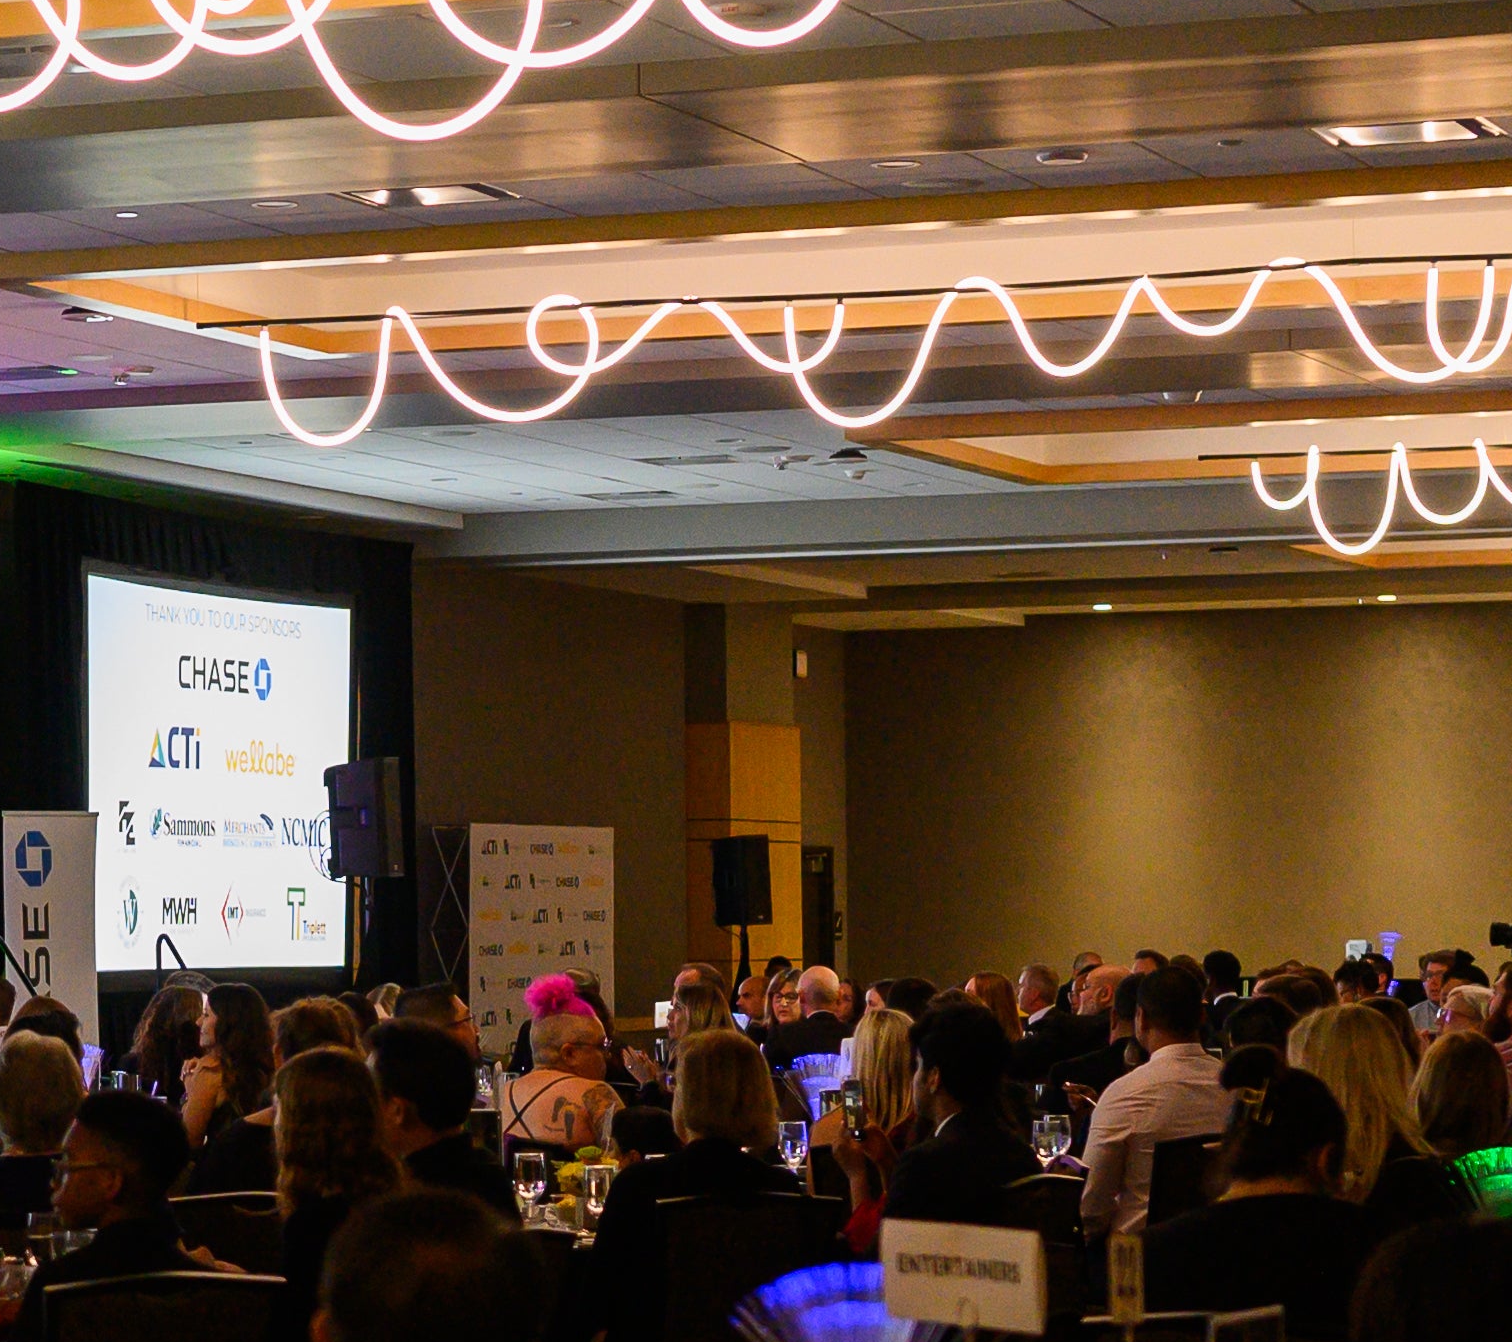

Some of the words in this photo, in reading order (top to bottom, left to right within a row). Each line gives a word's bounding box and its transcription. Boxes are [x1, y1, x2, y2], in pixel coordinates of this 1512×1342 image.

[145, 603, 181, 625] THANK
[183, 608, 205, 627] YOU
[208, 609, 222, 628] TO
[223, 612, 246, 632] OUR
[248, 615, 302, 639] SPONSORS
[178, 655, 250, 694] CHASE
[167, 726, 201, 770] CTi
[225, 739, 296, 777] wellabe
[163, 811, 216, 837] Sammons
[281, 816, 327, 847] NCMIC
[162, 897, 197, 925] MWH
[895, 1251, 1022, 1284] ENTERTAINERS
